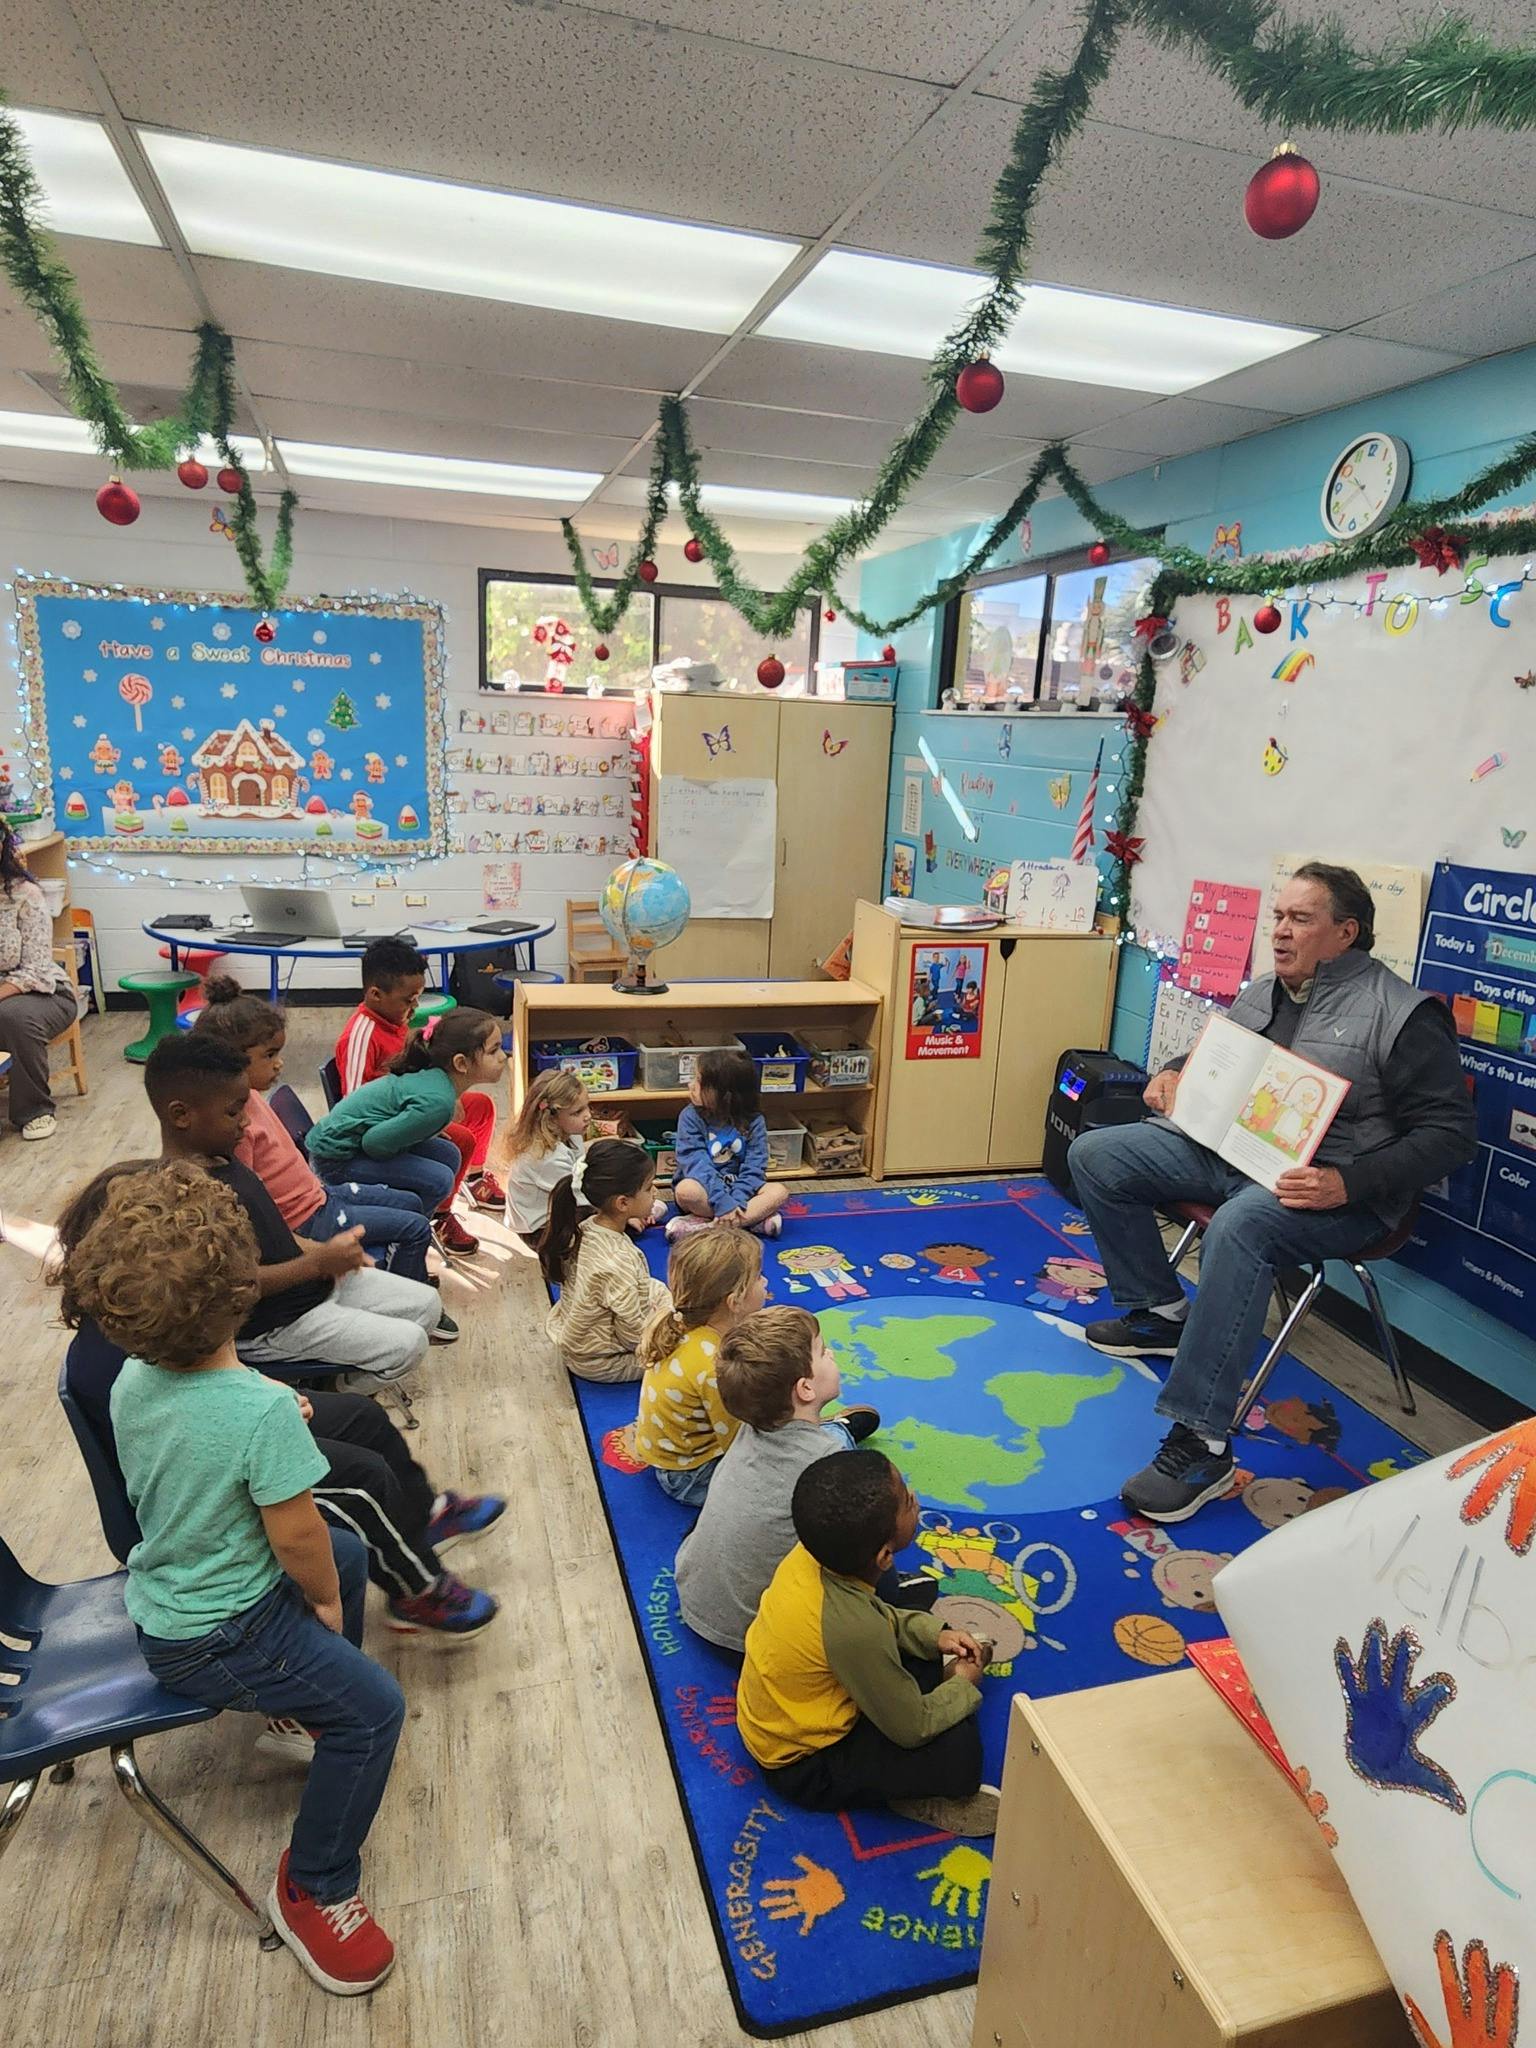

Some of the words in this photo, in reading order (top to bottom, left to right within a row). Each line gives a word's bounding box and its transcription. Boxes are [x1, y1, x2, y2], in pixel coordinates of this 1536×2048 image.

[1215, 597, 1310, 655] BAK
[1366, 573, 1419, 637] TO
[100, 641, 152, 658] Have
[166, 648, 179, 660] a
[192, 643, 250, 663] Sweet
[260, 648, 351, 668] Christmas
[1434, 933, 1465, 954] Today
[1466, 940, 1475, 954] is
[1474, 979, 1501, 999] Days
[1503, 986, 1516, 1001] of
[1517, 989, 1535, 1006] the
[917, 1045, 970, 1057] Movement
[925, 1035, 954, 1046] Music
[955, 1034, 964, 1045] &
[1460, 1053, 1495, 1076] What's
[1496, 1066, 1515, 1082] the
[1050, 1111, 1077, 1141] ION
[1499, 1166, 1531, 1190] Color
[946, 1268, 967, 1280] 4
[1344, 1489, 1536, 1673] Welb
[648, 1566, 684, 1656] HONESTY
[674, 1685, 756, 1787] SHARING
[726, 1798, 786, 1981] GENEROSITY
[861, 1906, 978, 1950] IENCE
